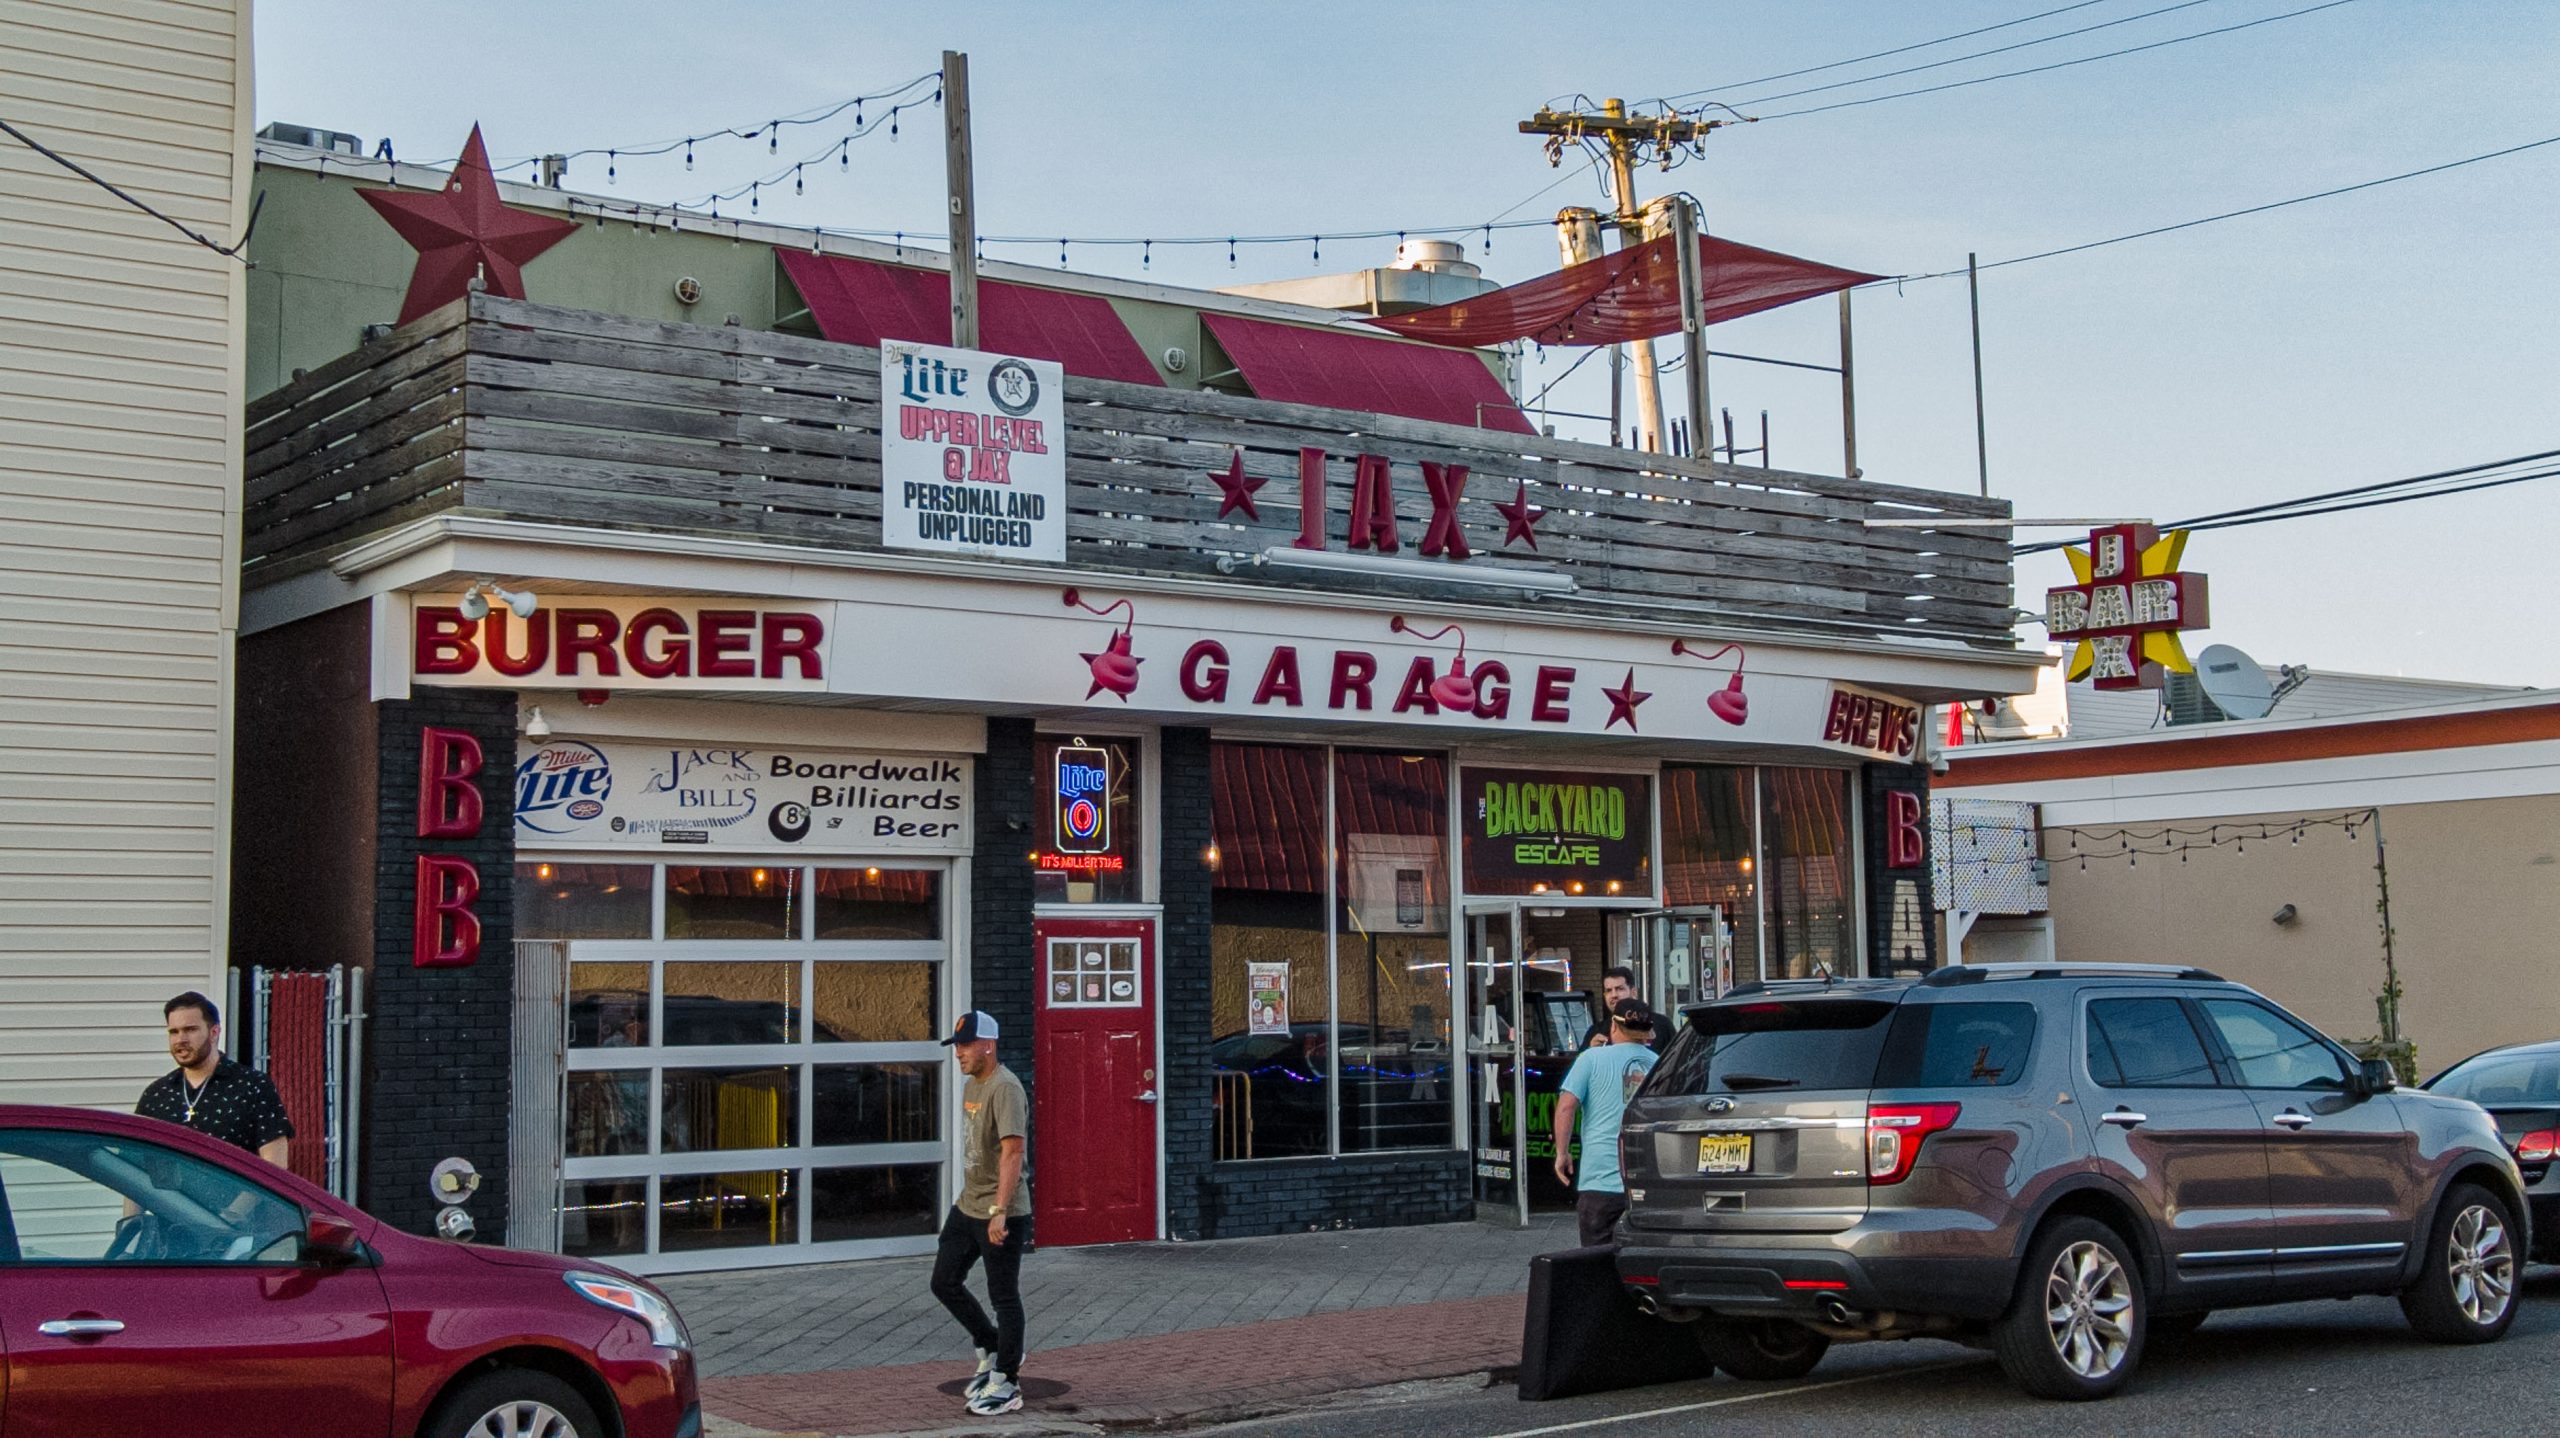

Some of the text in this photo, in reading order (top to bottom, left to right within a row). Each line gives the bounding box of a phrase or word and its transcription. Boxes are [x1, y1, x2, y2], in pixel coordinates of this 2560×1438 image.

[900, 353, 969, 403] Lite
[900, 405, 1048, 454] UPPER LEVEL
[968, 447, 1011, 484] JAX
[904, 481, 1045, 521] PERSONAL AND
[1292, 446, 1471, 559] JAX
[918, 511, 1032, 548] UNPLUGGED
[2046, 580, 2178, 634] BAR
[415, 605, 824, 680] BURGER
[1179, 639, 1576, 723] GARAGE
[1823, 689, 1918, 757] BREWS
[539, 750, 595, 767] Miller
[770, 755, 960, 783] Boardwalk
[514, 765, 608, 813] Lite
[810, 785, 961, 810] Billiards
[1059, 764, 1105, 797] Lite
[679, 788, 757, 814] BILLS
[1485, 781, 1625, 841] BACKYARD
[873, 815, 960, 838] Beer
[1514, 844, 1600, 866] ESCAPE
